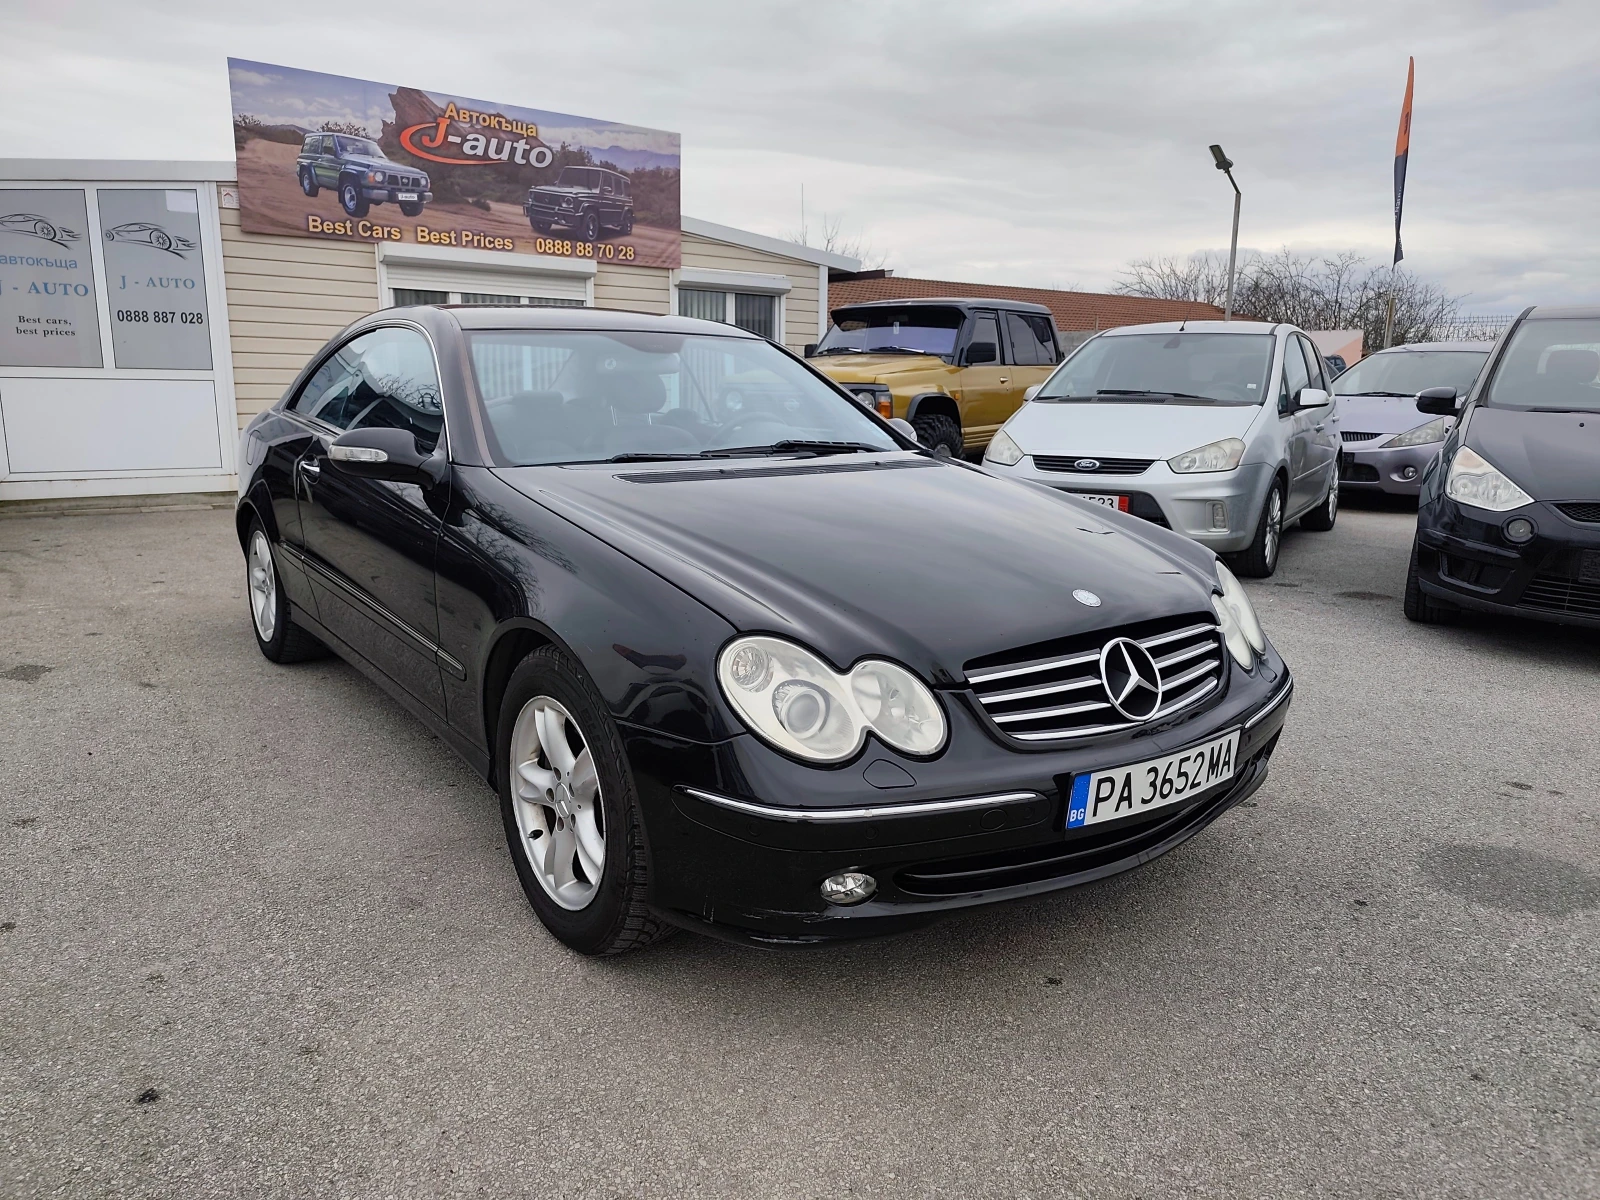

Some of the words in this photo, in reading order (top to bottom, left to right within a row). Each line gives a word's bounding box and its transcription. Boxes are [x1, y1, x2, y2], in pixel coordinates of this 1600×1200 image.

[421, 116, 553, 168] J-auto
[308, 215, 353, 235] Best
[358, 220, 402, 240] Cars
[416, 226, 457, 245] Best
[461, 231, 513, 250] Prices
[536, 238, 572, 255] 0888
[576, 241, 593, 257] 88
[597, 243, 614, 259] 70
[618, 246, 635, 260] 28
[28, 281, 89, 297] AUTO
[119, 275, 126, 290] J
[146, 277, 196, 290] AUTO
[18, 315, 41, 324] Best
[46, 318, 72, 326] cars,
[117, 309, 149, 323] 0888
[153, 311, 176, 323] 887
[180, 312, 204, 325] 028
[16, 327, 38, 335] best
[43, 328, 76, 337] prices
[1069, 809, 1085, 822] BG
[1092, 771, 1133, 817] PA
[1140, 751, 1205, 805] 3652
[1205, 738, 1232, 784] MA
